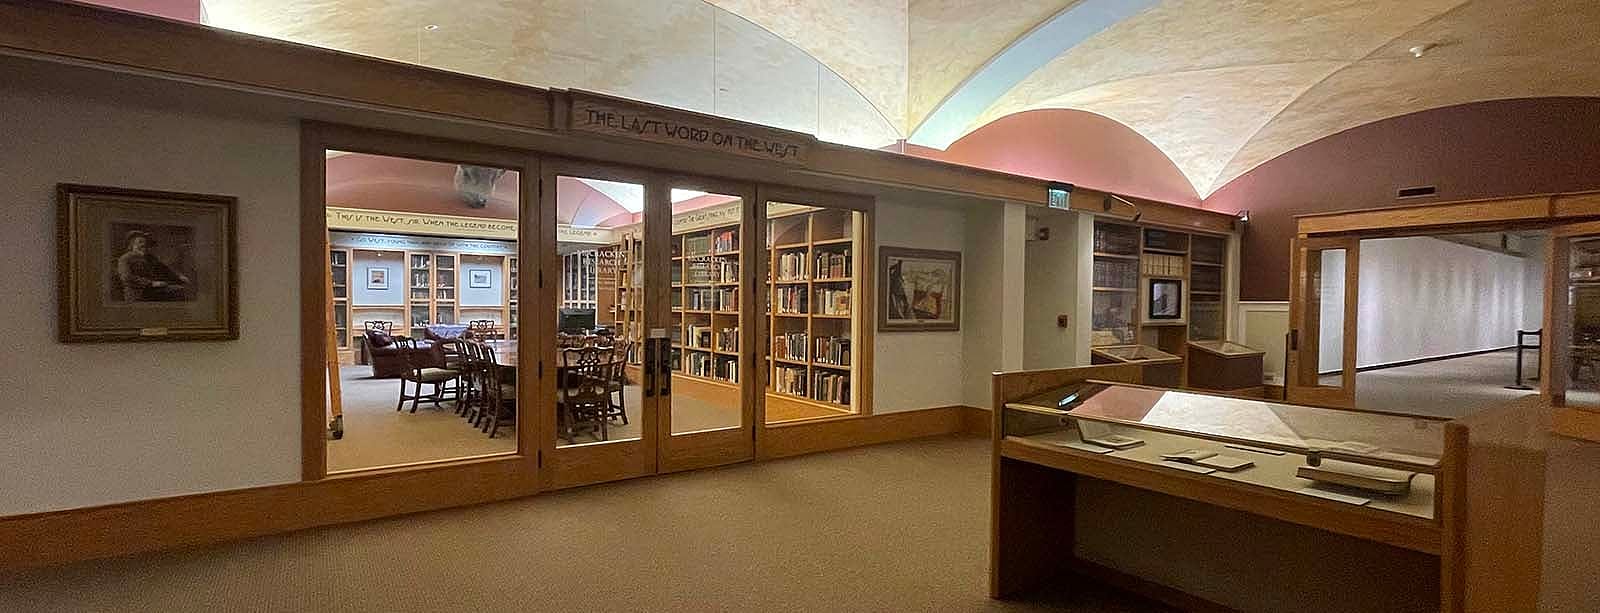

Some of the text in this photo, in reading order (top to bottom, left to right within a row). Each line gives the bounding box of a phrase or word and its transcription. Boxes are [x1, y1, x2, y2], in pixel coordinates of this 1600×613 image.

[586, 108, 800, 158] THE LAST WORD ON THE WEST
